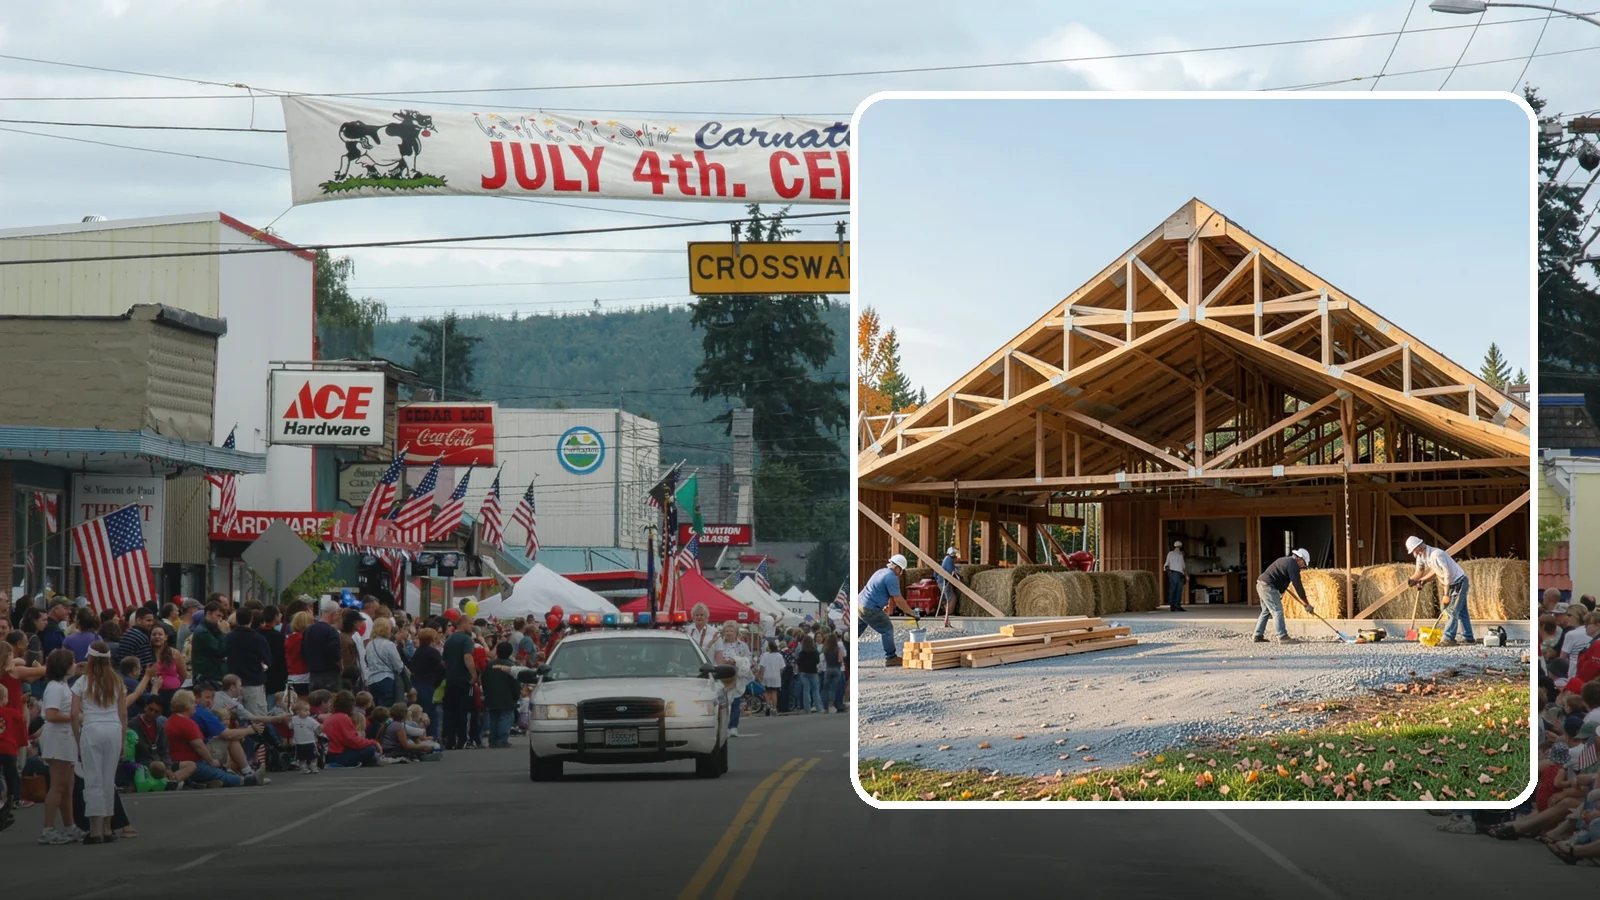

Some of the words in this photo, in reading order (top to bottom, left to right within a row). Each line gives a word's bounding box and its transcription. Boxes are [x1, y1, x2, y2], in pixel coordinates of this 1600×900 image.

[481, 141, 605, 192] JULY
[632, 149, 746, 197] 4th.
[697, 254, 850, 280] CROSSWA
[283, 380, 373, 420] ACE
[405, 409, 452, 422] CEDAR
[461, 409, 485, 421] LOG
[283, 421, 371, 436] Hardware
[416, 428, 477, 447] Coca-Cola
[353, 467, 386, 479] Simpl
[95, 485, 124, 495] Vincent
[126, 486, 136, 495] de
[138, 486, 155, 495] Paul
[213, 516, 331, 535] HARDARE
[688, 526, 741, 535] CRNATION
[699, 535, 730, 543] GLASS
